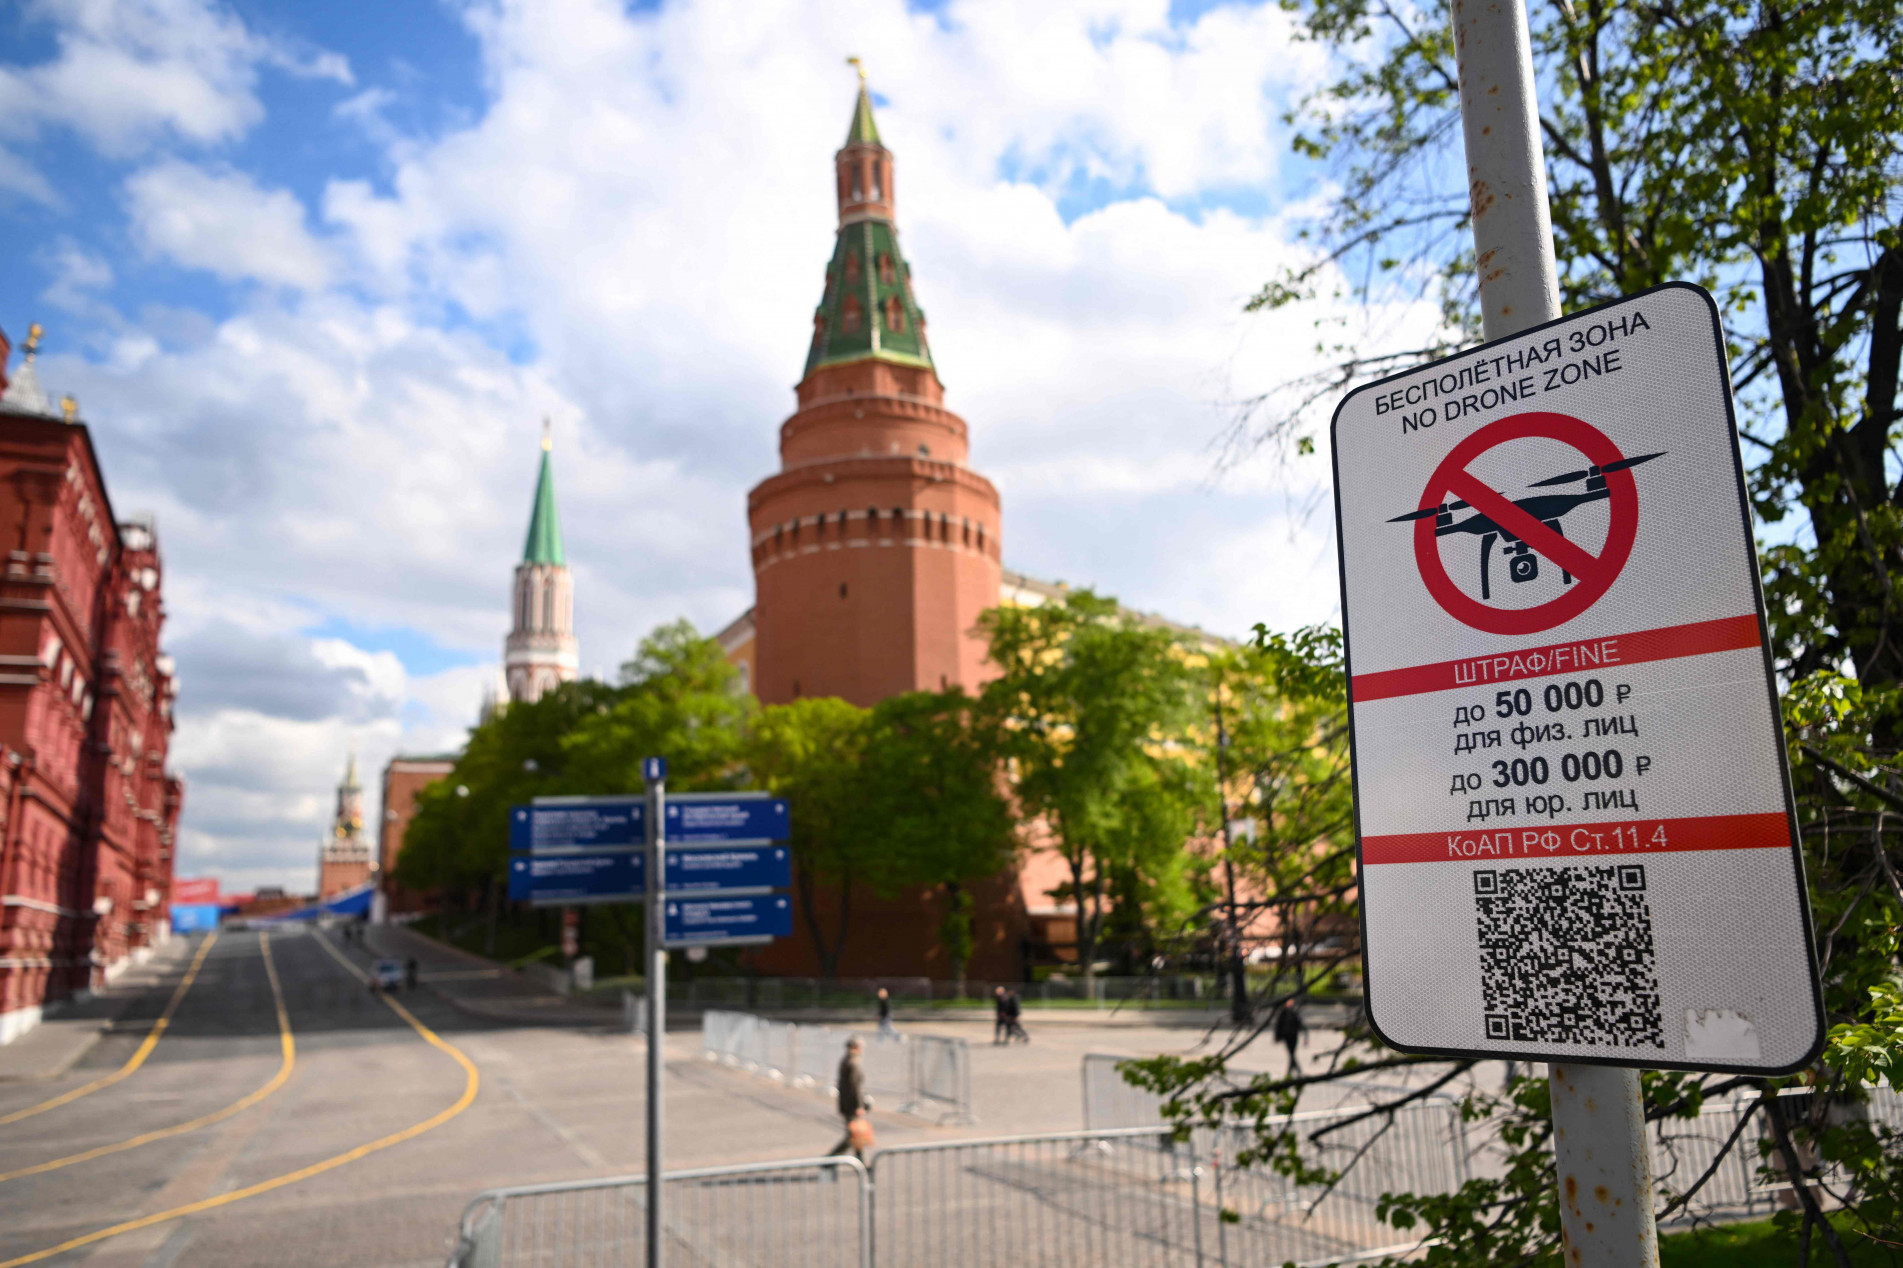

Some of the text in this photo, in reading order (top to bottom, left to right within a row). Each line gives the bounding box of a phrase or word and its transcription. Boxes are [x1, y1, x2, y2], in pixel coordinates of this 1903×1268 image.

[1375, 311, 1651, 416] БЕСПОЛЁТНАЯ ЗОНА
[1402, 350, 1623, 434] NO DRONE ZONE
[1454, 639, 1621, 685] ШТРАФ/FINE
[1453, 705, 1485, 728] до
[1495, 688, 1532, 719] 50
[1543, 679, 1604, 713] 000
[1454, 713, 1639, 755] для физ. лиц
[1450, 773, 1481, 796] до
[1492, 756, 1549, 788] 300
[1561, 749, 1623, 783] 000
[1467, 788, 1639, 822] для юр. лиц
[1447, 824, 1668, 858] КоАП РФ Ст.11.4
